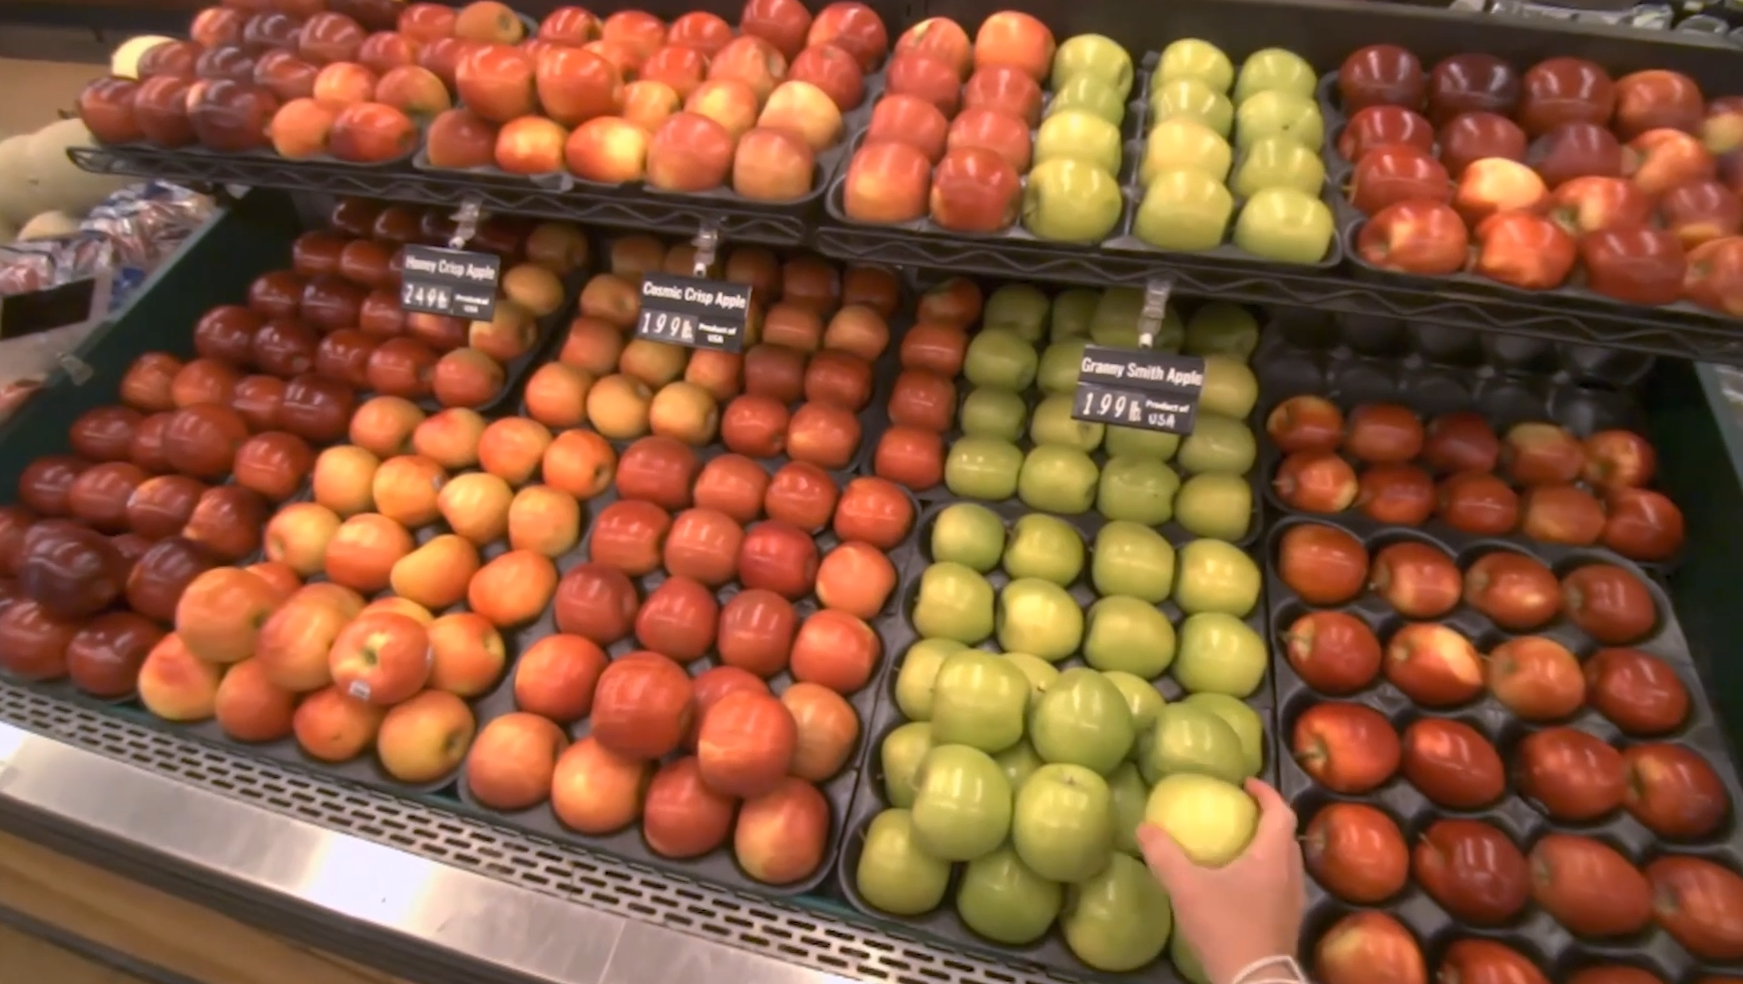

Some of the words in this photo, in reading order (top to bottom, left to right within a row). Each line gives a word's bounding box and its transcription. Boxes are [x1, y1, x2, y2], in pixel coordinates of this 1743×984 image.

[438, 259, 464, 277] Crisp
[466, 263, 495, 281] Apple
[642, 281, 682, 300] Cosmic
[684, 287, 713, 306] Crisp
[715, 292, 746, 309] Apple
[698, 323, 728, 334] Product
[728, 327, 737, 335] of
[707, 334, 724, 344] USA
[1081, 357, 1125, 379] Granny
[1127, 362, 1164, 380] Smith
[1166, 367, 1203, 386] Apple
[1145, 400, 1178, 412] Product
[1179, 404, 1190, 413] of
[1148, 413, 1175, 428] USA
